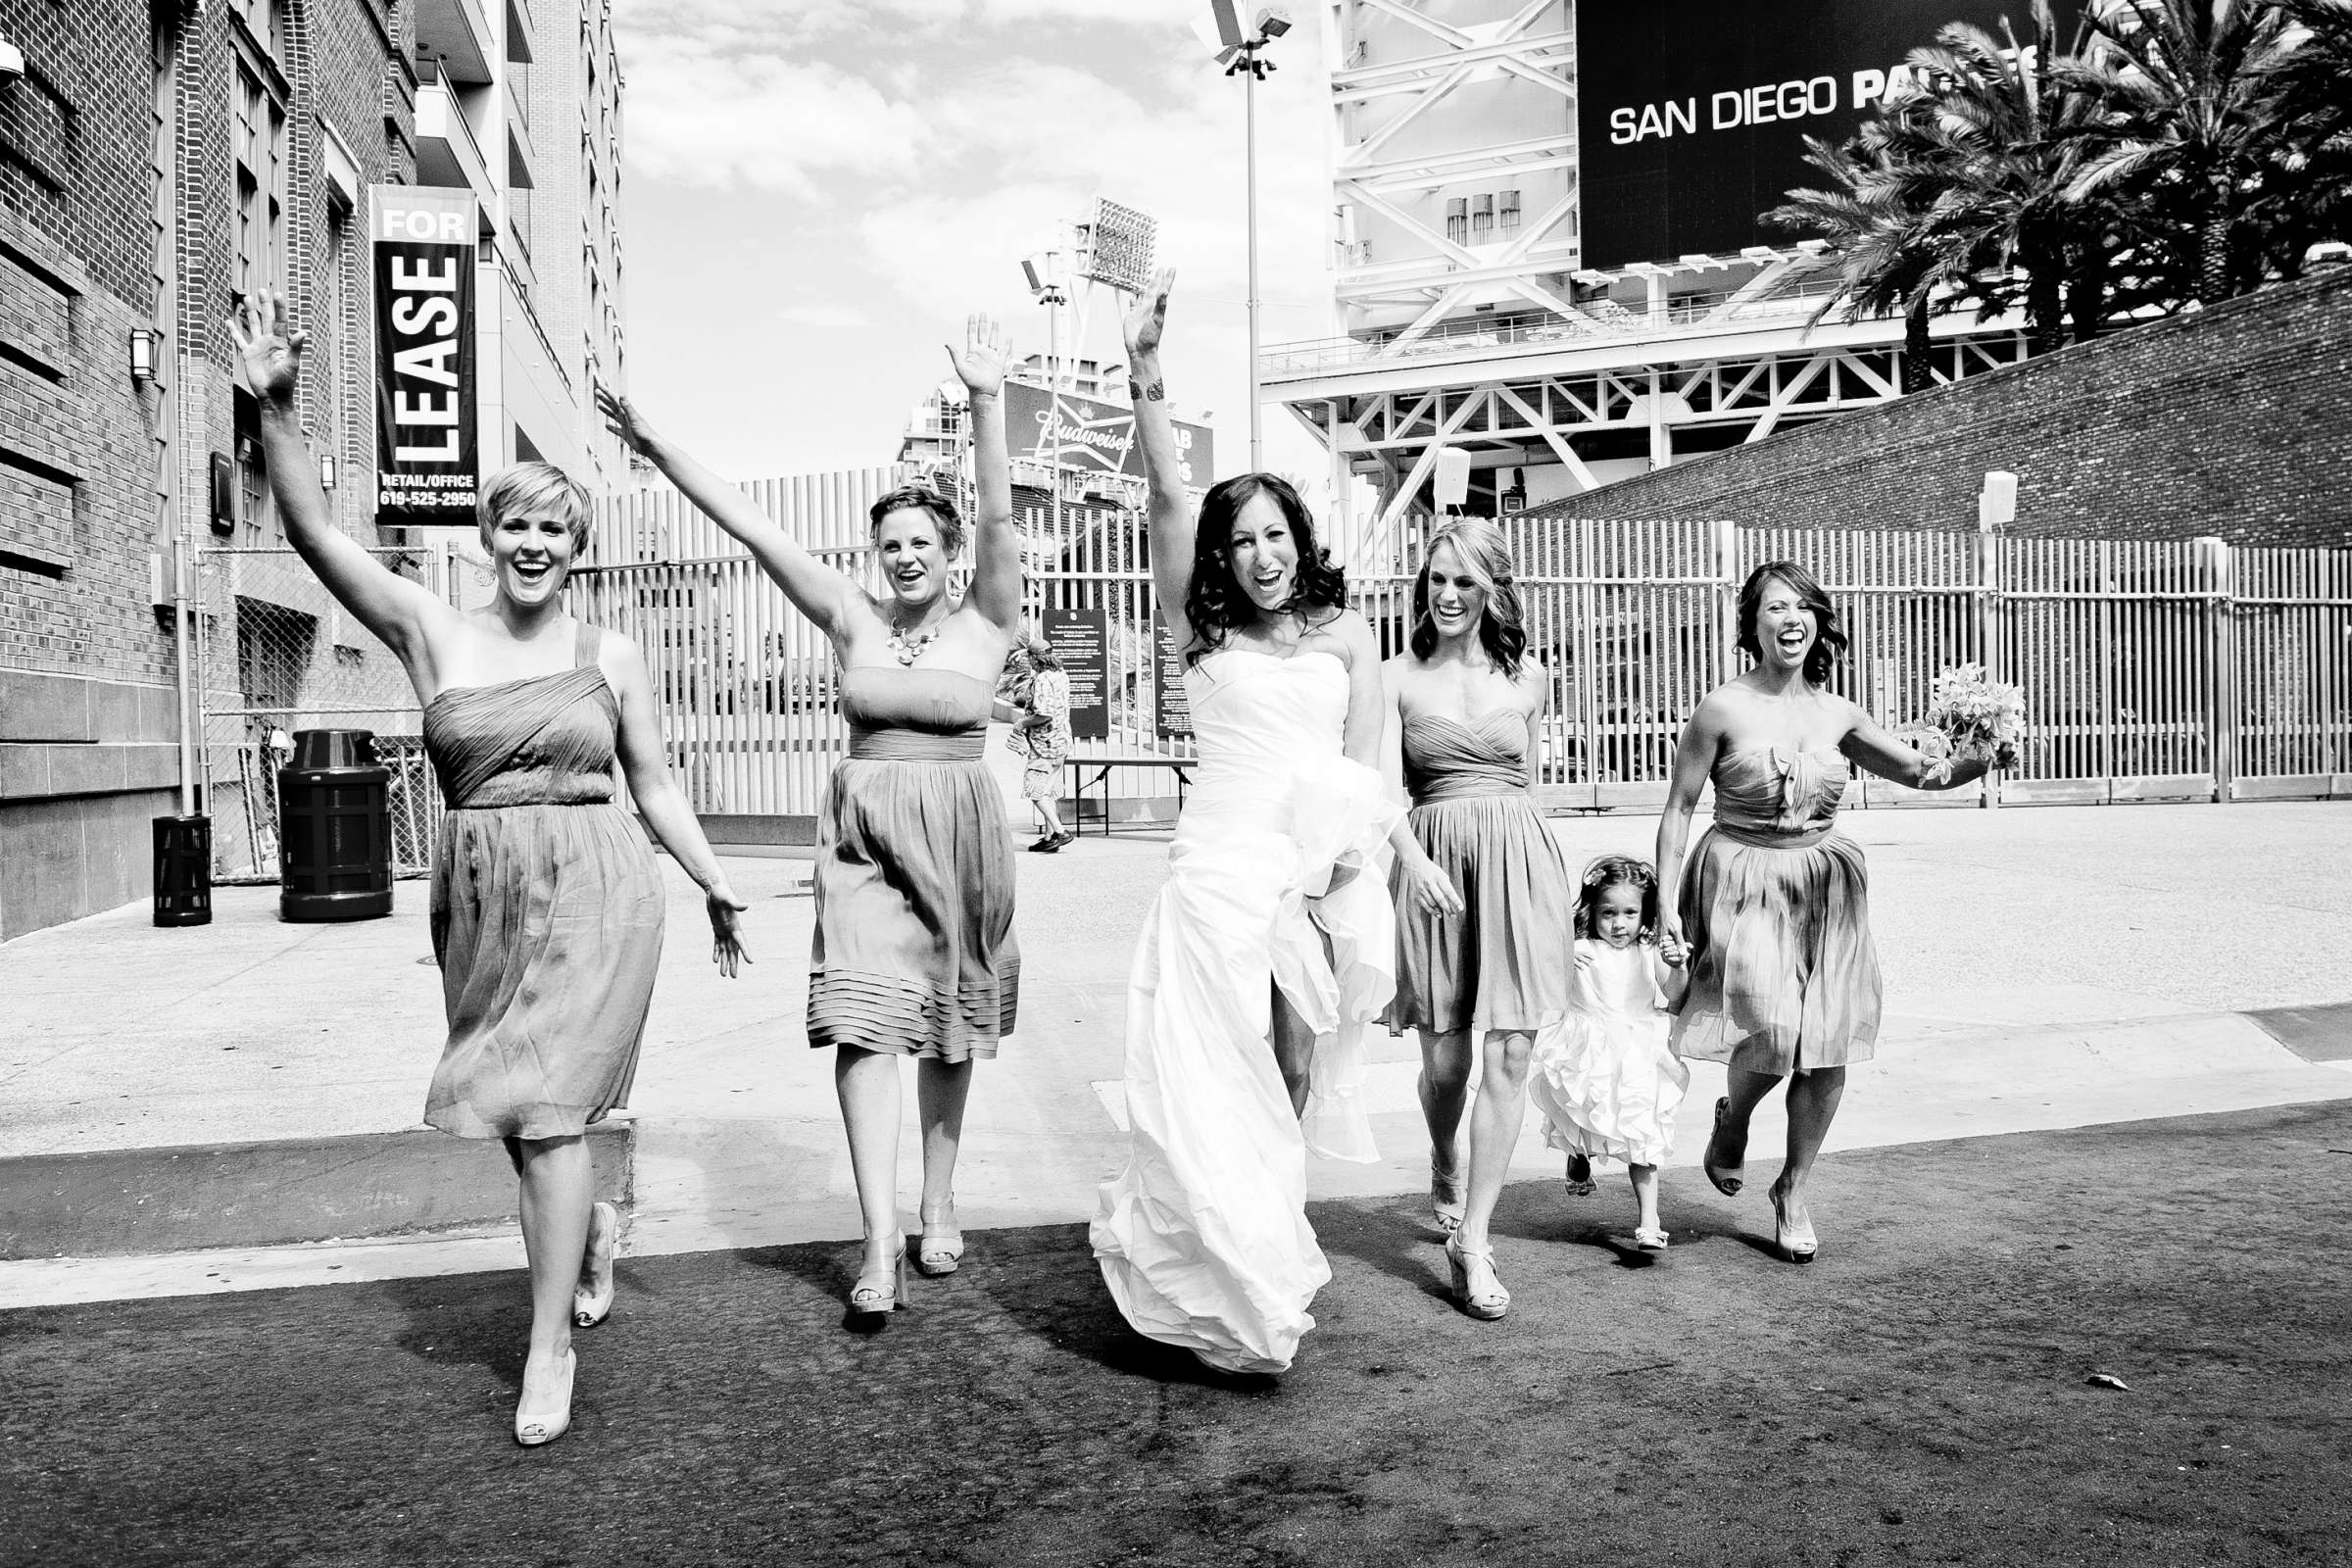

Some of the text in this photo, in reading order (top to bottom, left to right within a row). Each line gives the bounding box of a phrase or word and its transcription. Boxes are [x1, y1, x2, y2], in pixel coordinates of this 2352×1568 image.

[1610, 98, 1695, 146] SAN
[1712, 75, 1837, 130] DIEGO
[383, 210, 465, 241] FOR
[392, 256, 461, 463] LEASE
[1035, 407, 1135, 452] Budweiser
[379, 490, 476, 507] 619-525-2950
[382, 473, 474, 488] RETAIL/OFFICE
